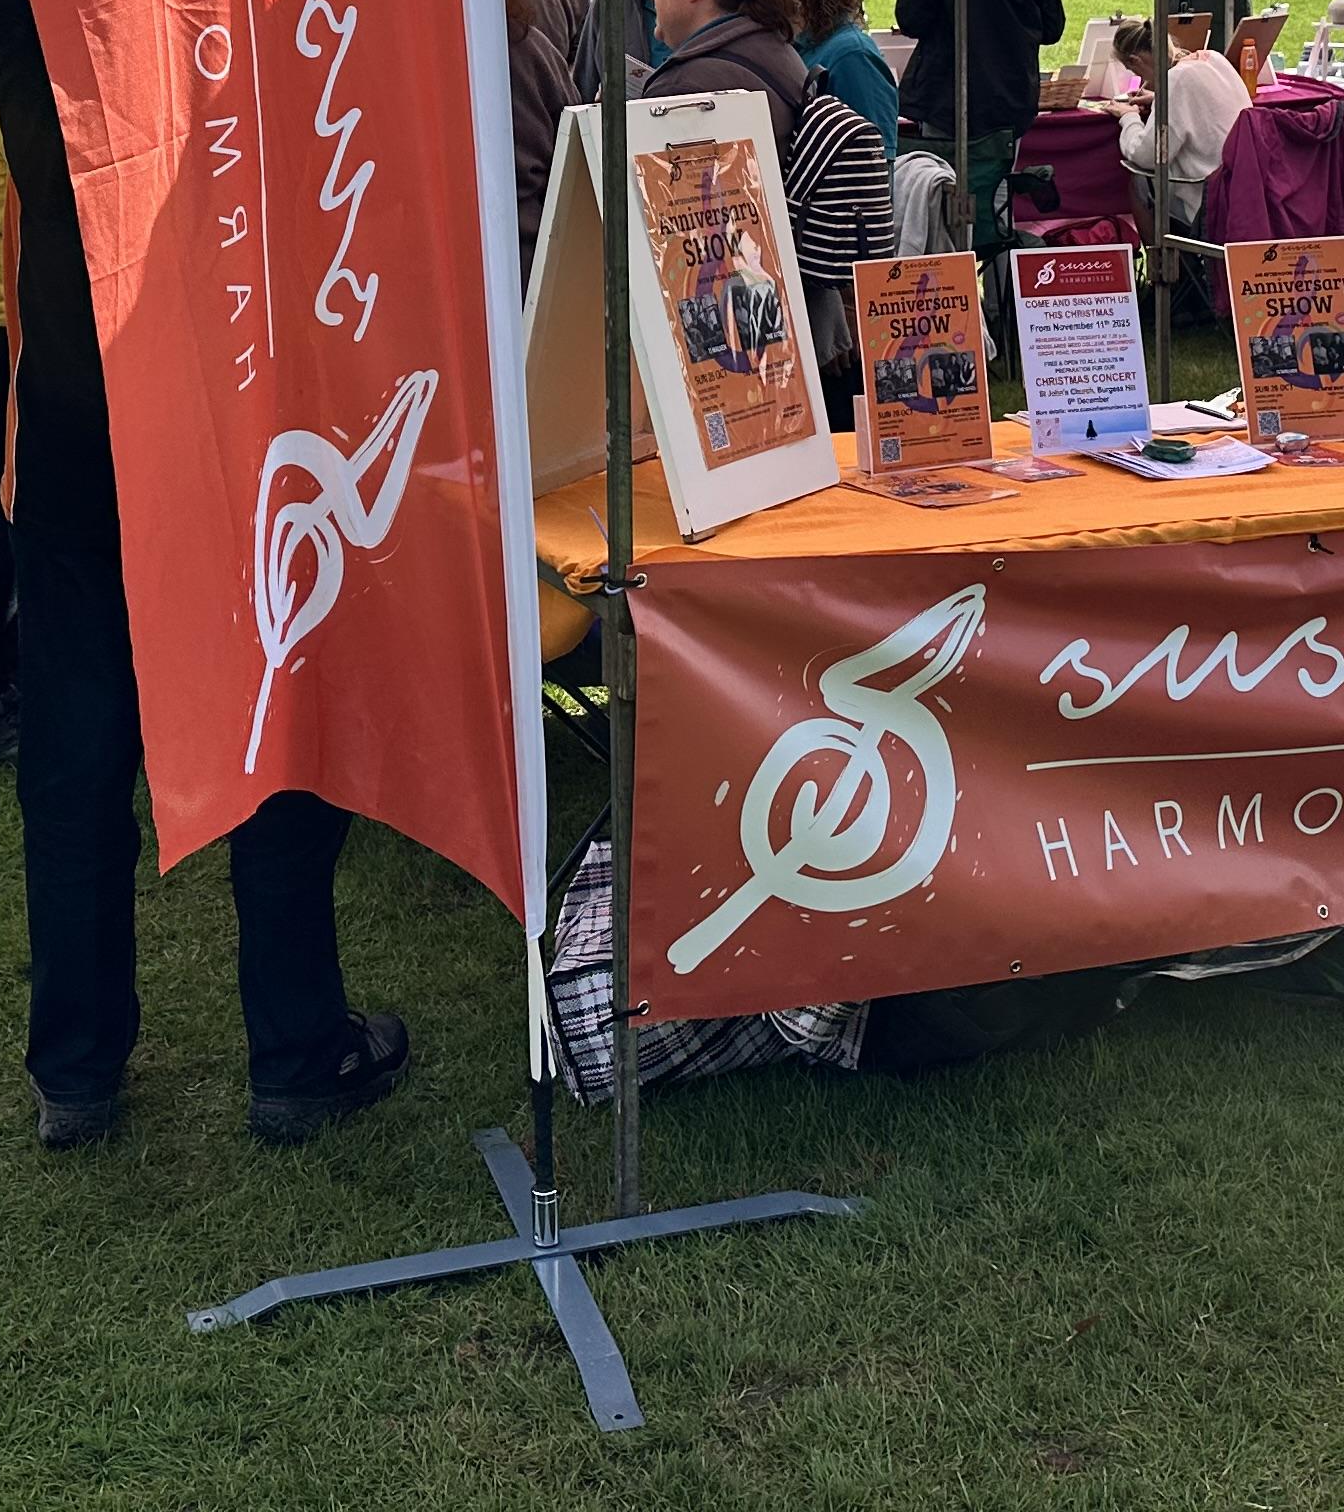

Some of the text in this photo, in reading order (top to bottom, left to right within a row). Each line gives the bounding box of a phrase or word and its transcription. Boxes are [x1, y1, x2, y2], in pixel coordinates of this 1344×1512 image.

[658, 201, 760, 237] Anniversary
[683, 228, 746, 267] SHOW
[1058, 260, 1112, 271] sussex
[867, 294, 969, 317] Anniversary
[1024, 295, 1129, 308] COME AND SING WITH US
[1266, 295, 1334, 317] SHOW
[1044, 308, 1114, 319] THIS CHRISTMAS
[890, 314, 951, 338] SHOW
[1029, 323, 1051, 333] From
[1052, 321, 1094, 331] November
[1111, 318, 1131, 328] 2025
[1034, 371, 1136, 386] CHRISTMAS CONCERT
[1076, 395, 1109, 404] December
